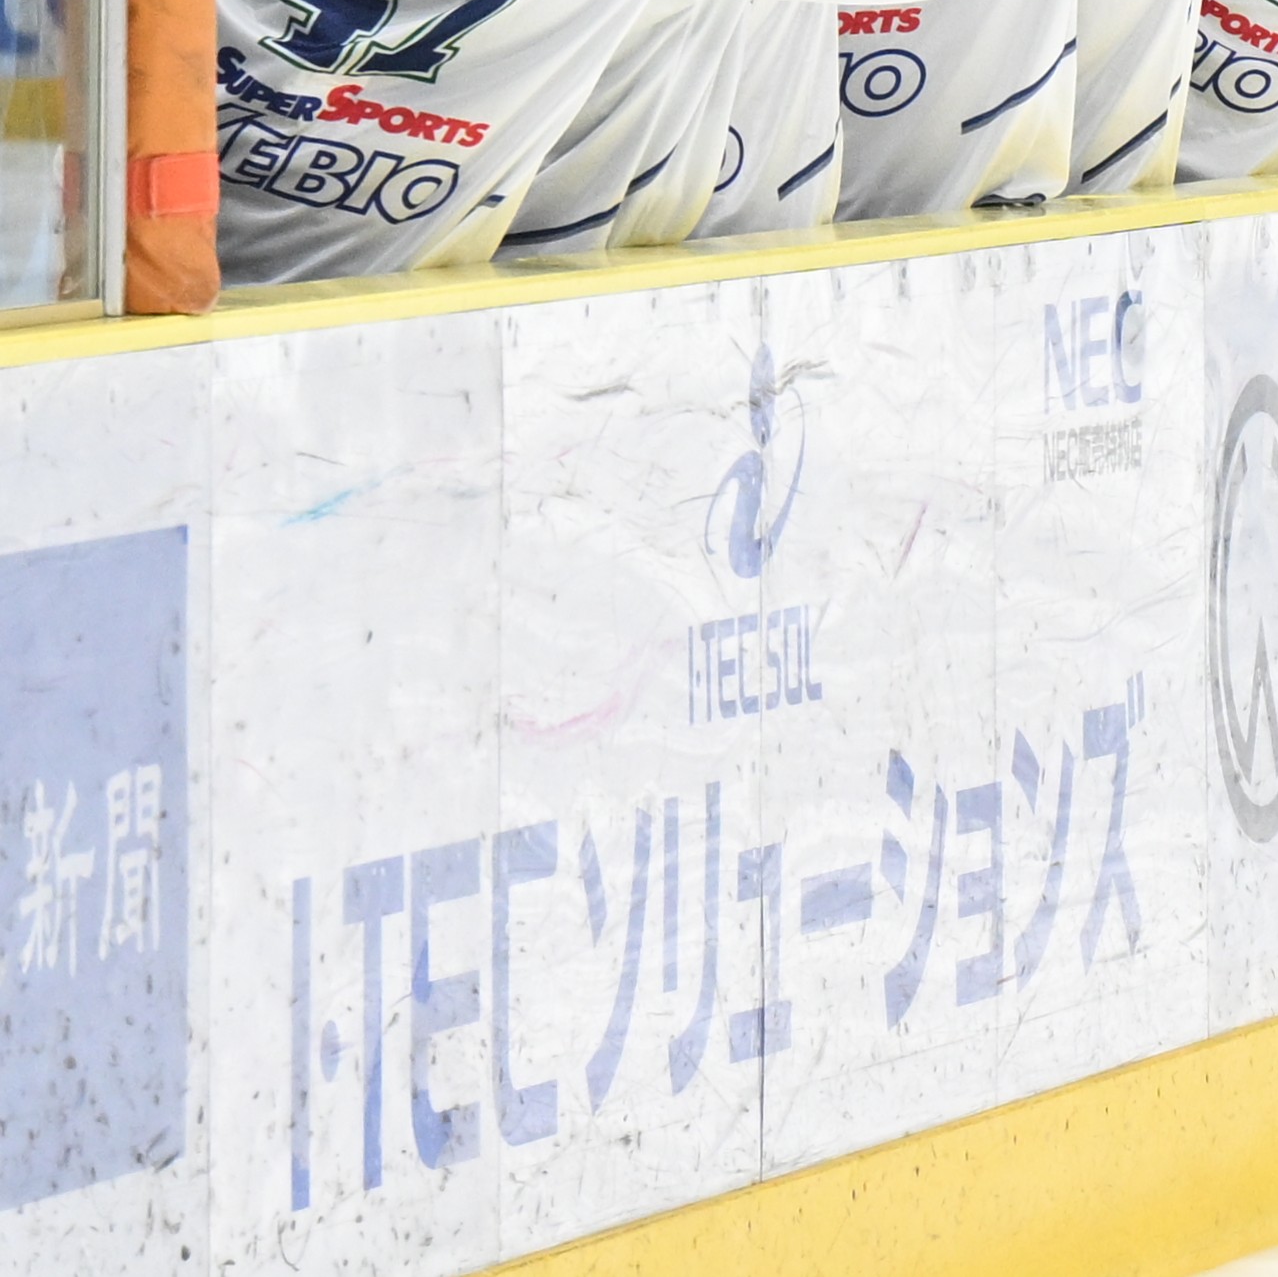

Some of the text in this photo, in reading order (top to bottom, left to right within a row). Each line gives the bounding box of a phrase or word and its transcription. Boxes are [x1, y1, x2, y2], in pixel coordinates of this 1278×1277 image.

[317, 83, 491, 149] SPORTS
[1043, 289, 1143, 415] NEC
[18, 763, 163, 980] 新聞
